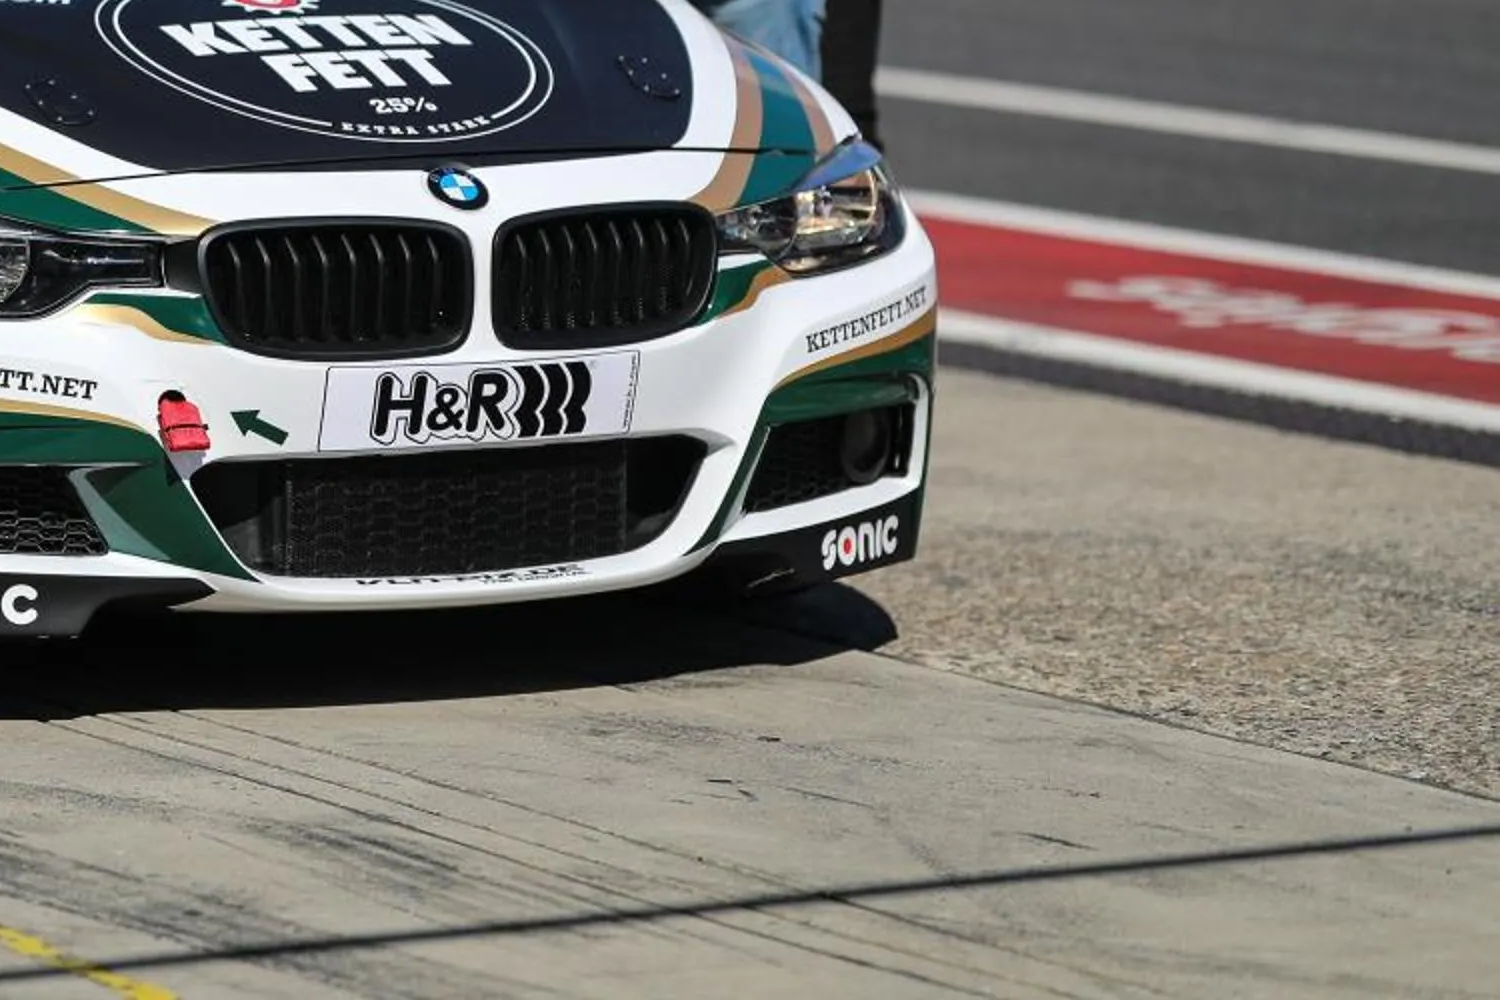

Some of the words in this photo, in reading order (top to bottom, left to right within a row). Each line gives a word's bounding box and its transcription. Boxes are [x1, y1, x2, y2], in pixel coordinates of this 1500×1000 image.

[159, 13, 474, 57] KETTEN
[260, 48, 453, 92] FETT
[368, 96, 439, 115] 25%
[340, 121, 420, 136] EXTRA
[806, 286, 927, 353] KETTENFETT.NET
[371, 369, 512, 444] H&R
[820, 514, 899, 572] SONIC
